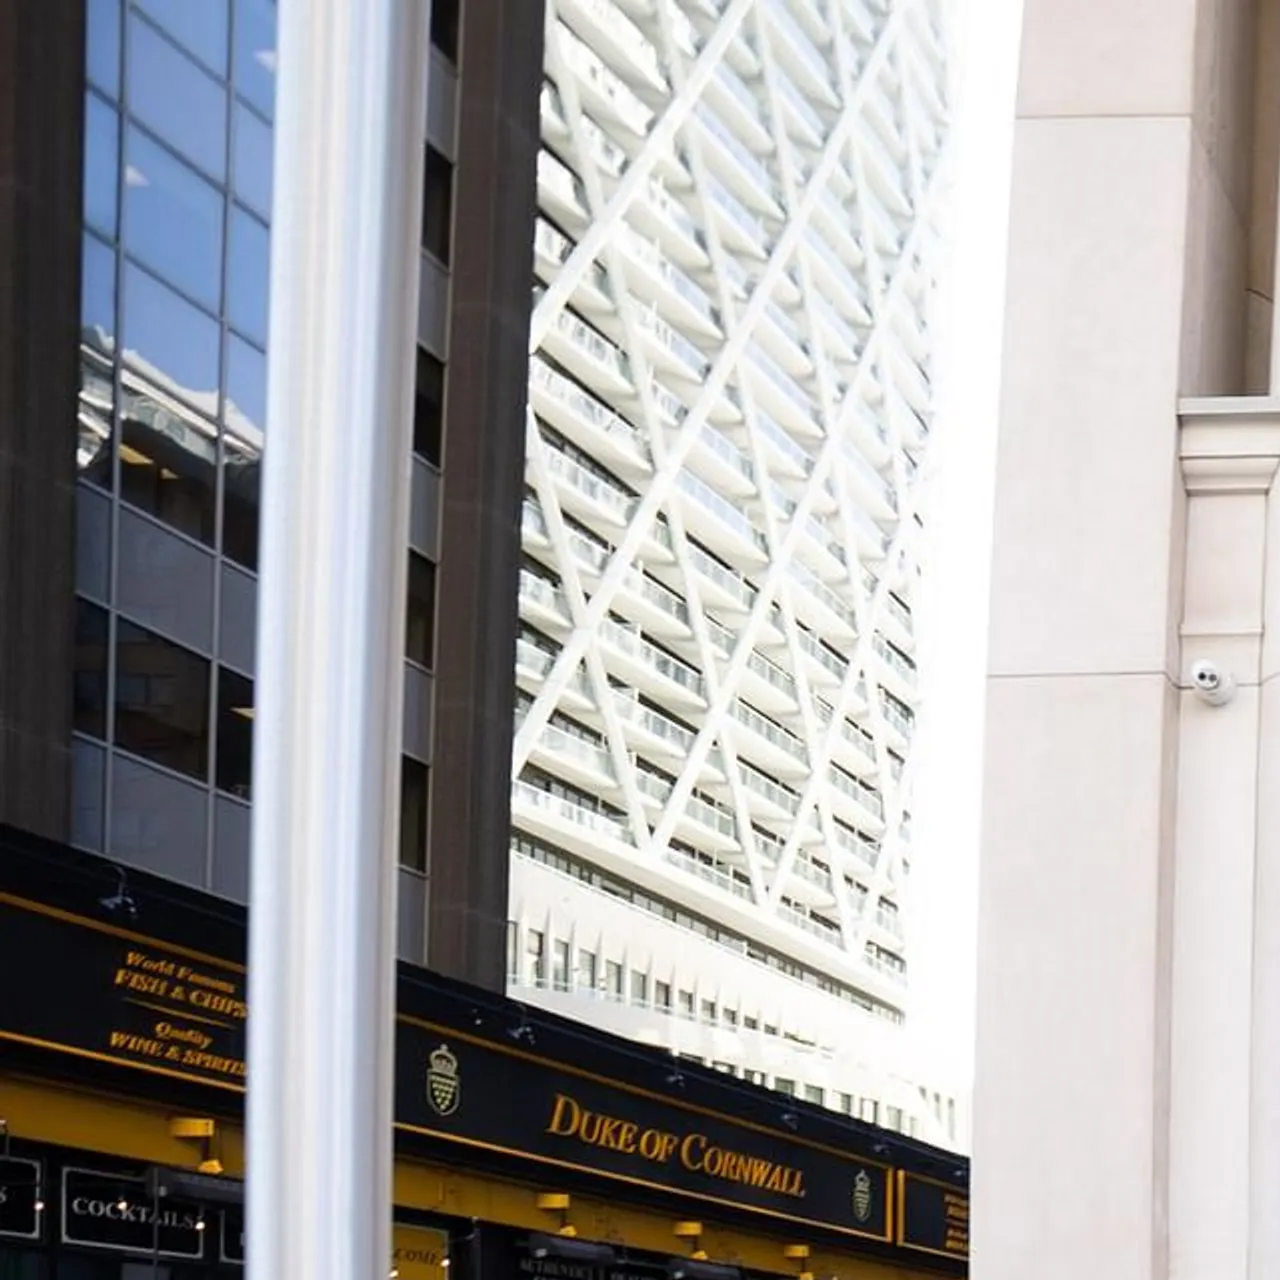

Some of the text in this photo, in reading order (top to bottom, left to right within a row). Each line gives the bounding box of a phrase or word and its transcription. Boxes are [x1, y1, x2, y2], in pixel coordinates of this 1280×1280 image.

[126, 951, 175, 975] World
[115, 968, 248, 1018] FISH & CHIPS
[110, 1031, 164, 1057] WINE
[165, 1045, 180, 1060] &
[155, 1021, 213, 1049] Quality
[639, 1129, 679, 1162] OF
[72, 1197, 197, 1230] COCKTAILS
